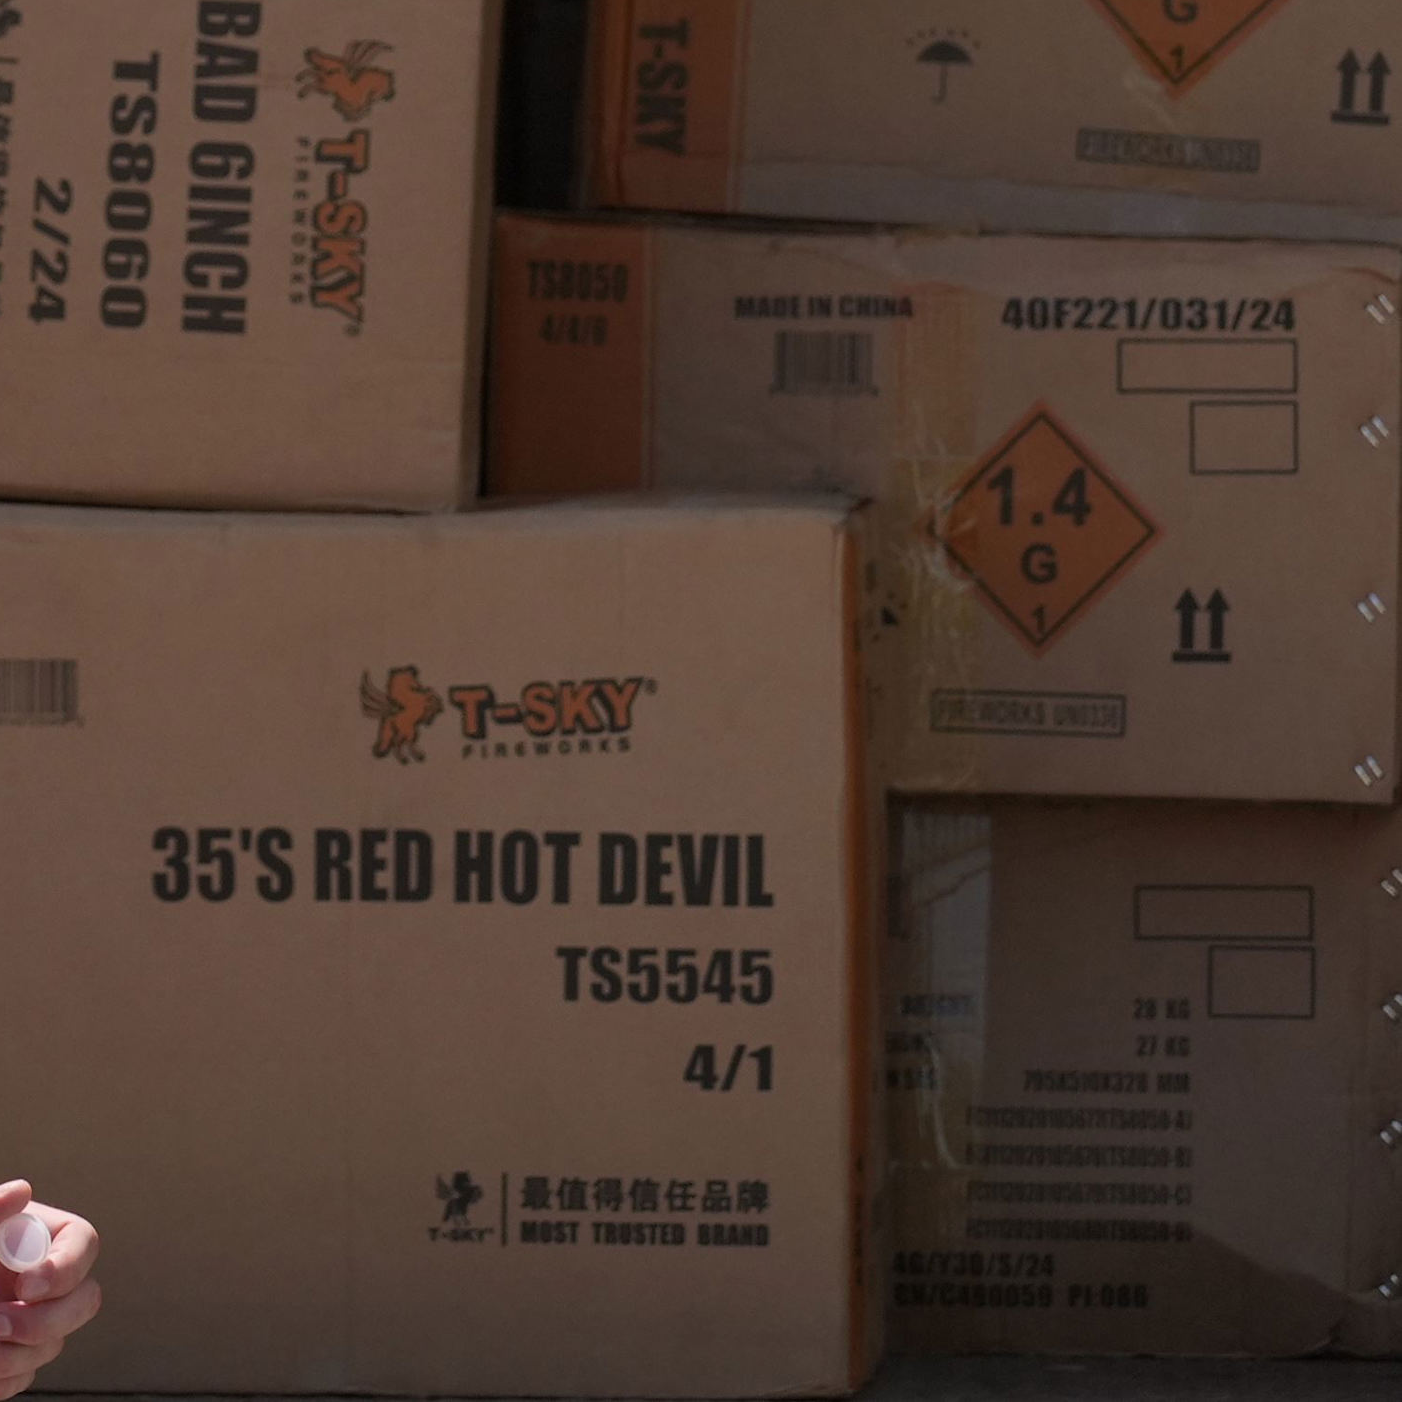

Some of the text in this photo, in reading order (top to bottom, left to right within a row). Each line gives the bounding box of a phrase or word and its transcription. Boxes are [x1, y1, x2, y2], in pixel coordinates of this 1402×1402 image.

[193, 0, 263, 124] BAD
[1168, 44, 1187, 74] 1
[634, 18, 690, 157] T-SKY
[100, 50, 161, 330] TS8060
[288, 136, 312, 306] FIREWORKS
[28, 176, 74, 325] 2/24
[733, 294, 914, 320] MADE IN CHINA
[1000, 296, 1297, 335] 40F221/031/24
[986, 466, 1091, 528] 1.4
[1019, 544, 1059, 585] G
[1030, 604, 1049, 635] 1
[448, 675, 644, 742] T-SKY
[460, 735, 633, 760] FIREWORKS
[150, 826, 776, 909] 35'S RED HOT DEVIL
[555, 945, 776, 1006] TS5545
[1164, 998, 1191, 1020] KG
[681, 1043, 776, 1093] 4/1
[1164, 1035, 1191, 1057] KG
[518, 1174, 771, 1217] 最值得信任品牌
[518, 1220, 770, 1248] MOST TRUSTED BRAND
